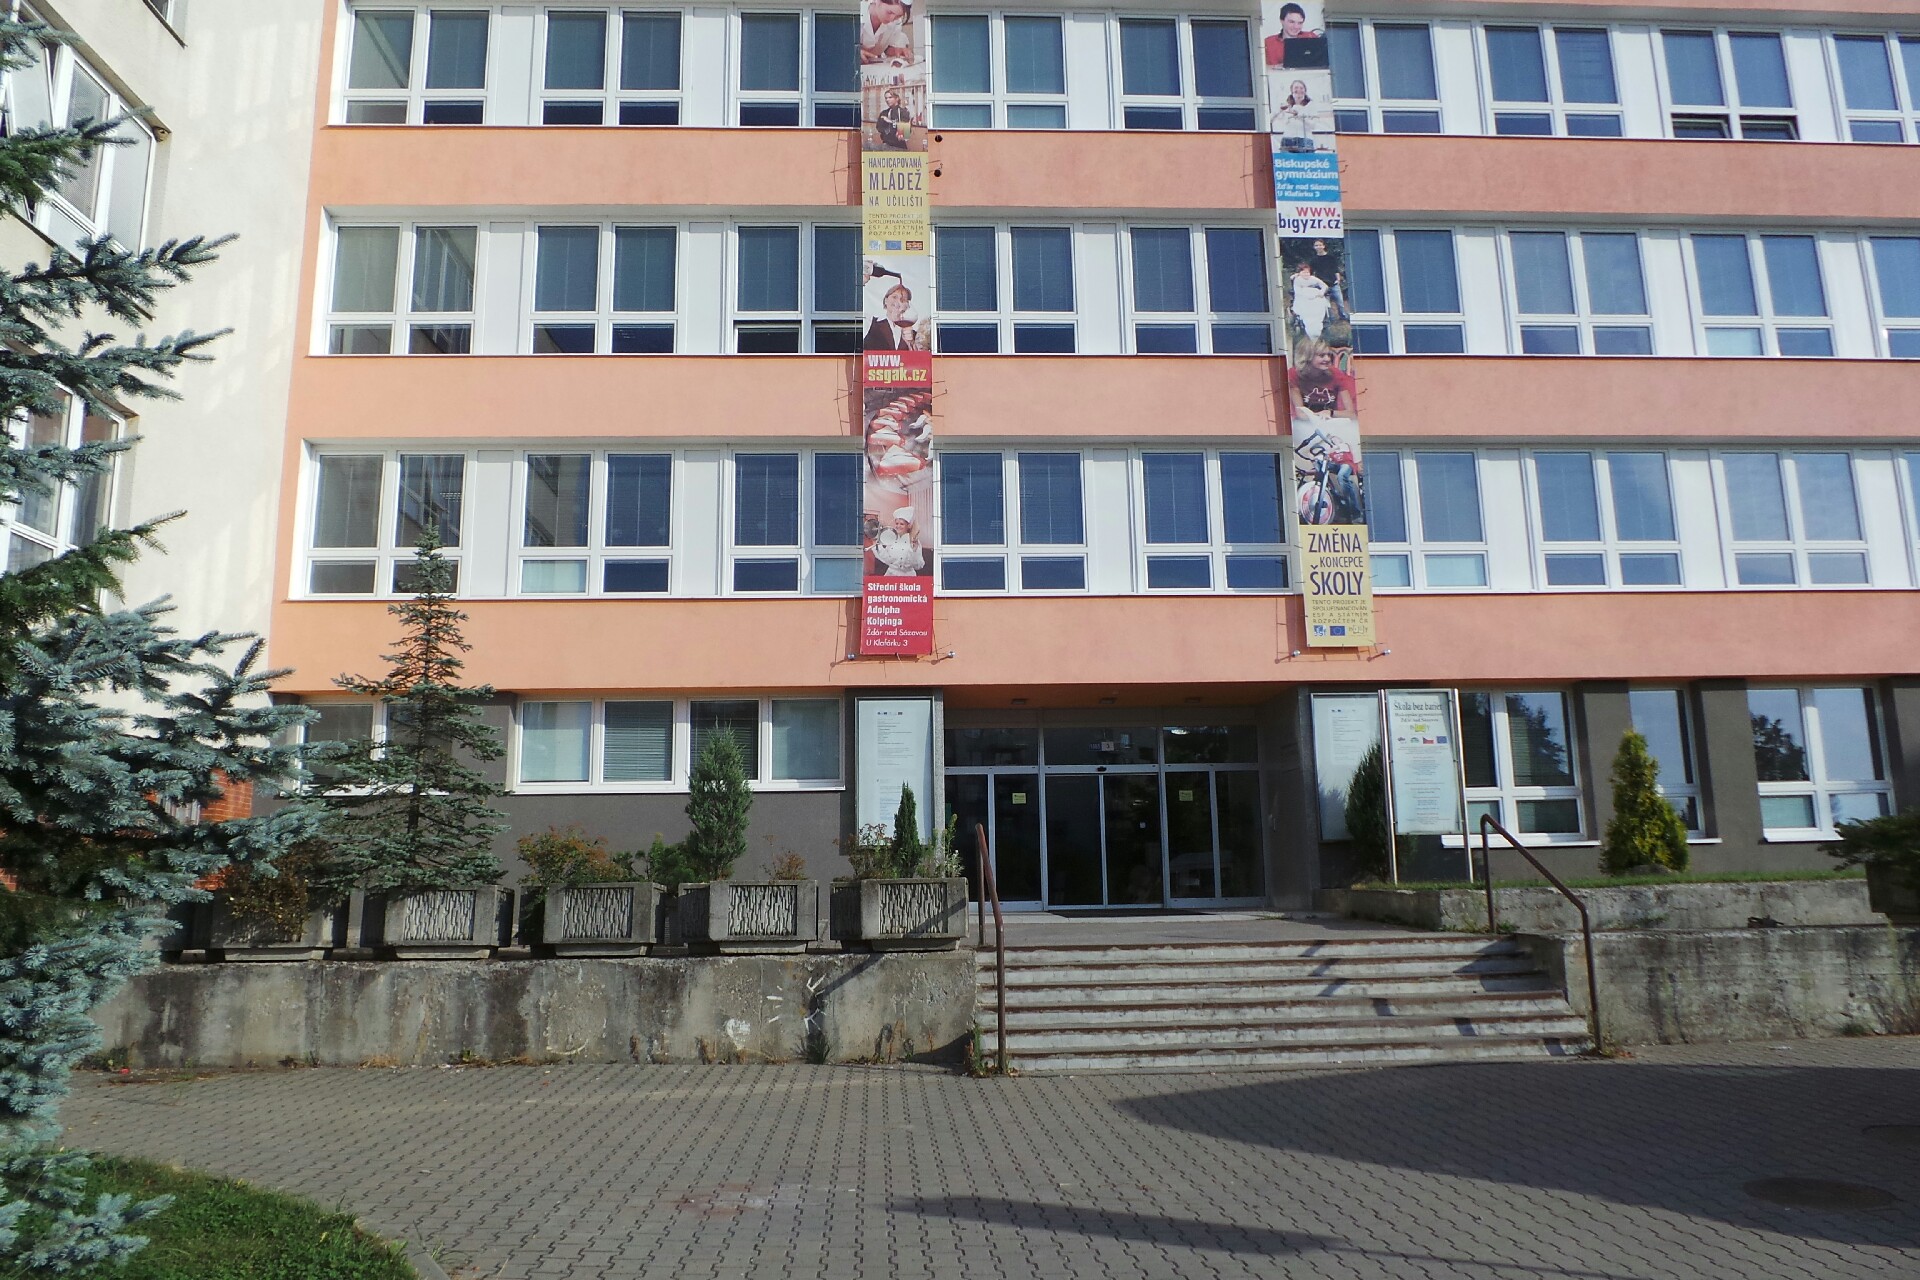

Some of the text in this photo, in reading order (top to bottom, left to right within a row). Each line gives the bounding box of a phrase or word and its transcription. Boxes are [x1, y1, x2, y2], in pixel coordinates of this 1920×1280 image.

[868, 157, 922, 168] HANDICAPOVANÁ
[1274, 159, 1329, 170] Biskupské
[870, 169, 922, 190] MLÁDEŽ
[1276, 170, 1338, 180] gymnázium
[869, 195, 922, 206] NA UČILIŠTI
[1296, 207, 1340, 217] www.
[1278, 213, 1340, 233] bigyzr.cz
[868, 354, 904, 367] www.
[868, 367, 927, 383] ssgak.cz
[1308, 528, 1362, 552] ZMĚNA
[1320, 556, 1363, 568] KONCEPCE
[1310, 565, 1363, 595] ŠKOLY
[868, 582, 921, 591] Střední škola
[868, 594, 928, 604] gastronomická
[867, 605, 900, 615] Adolpha
[867, 617, 902, 626] Kolpinga
[866, 627, 882, 636] Žďár
[1413, 702, 1423, 710] bez
